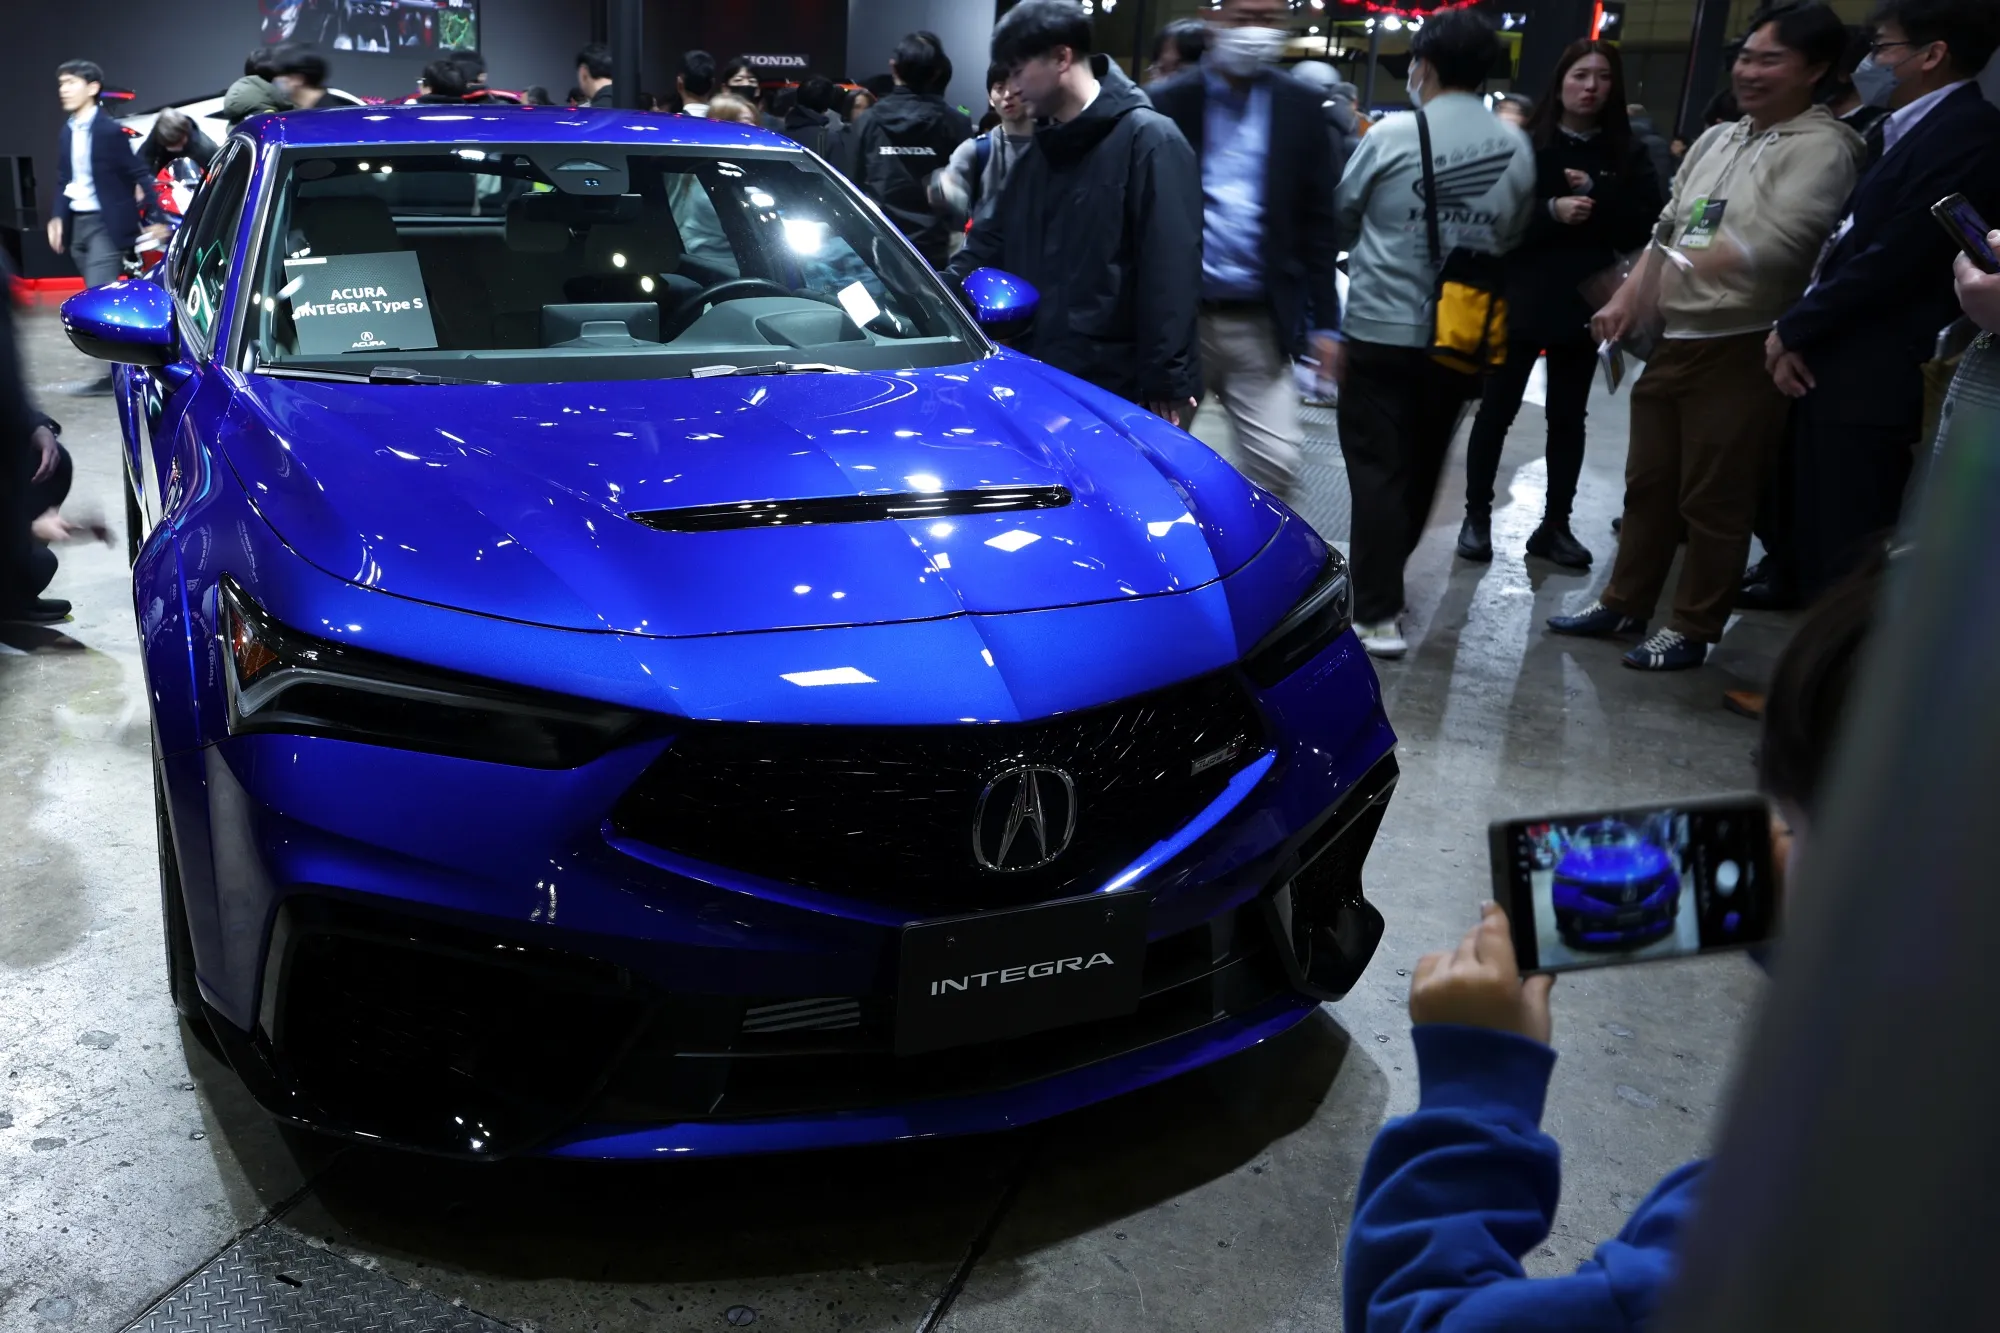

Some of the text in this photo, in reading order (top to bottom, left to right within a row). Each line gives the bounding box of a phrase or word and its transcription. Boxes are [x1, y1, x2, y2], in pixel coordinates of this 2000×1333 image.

[879, 146, 937, 156] HONDA
[330, 286, 388, 300] ACURA
[372, 299, 411, 314] Type
[412, 297, 424, 309] S
[351, 340, 387, 349] ACURA
[930, 952, 1115, 996] INTEGRA
